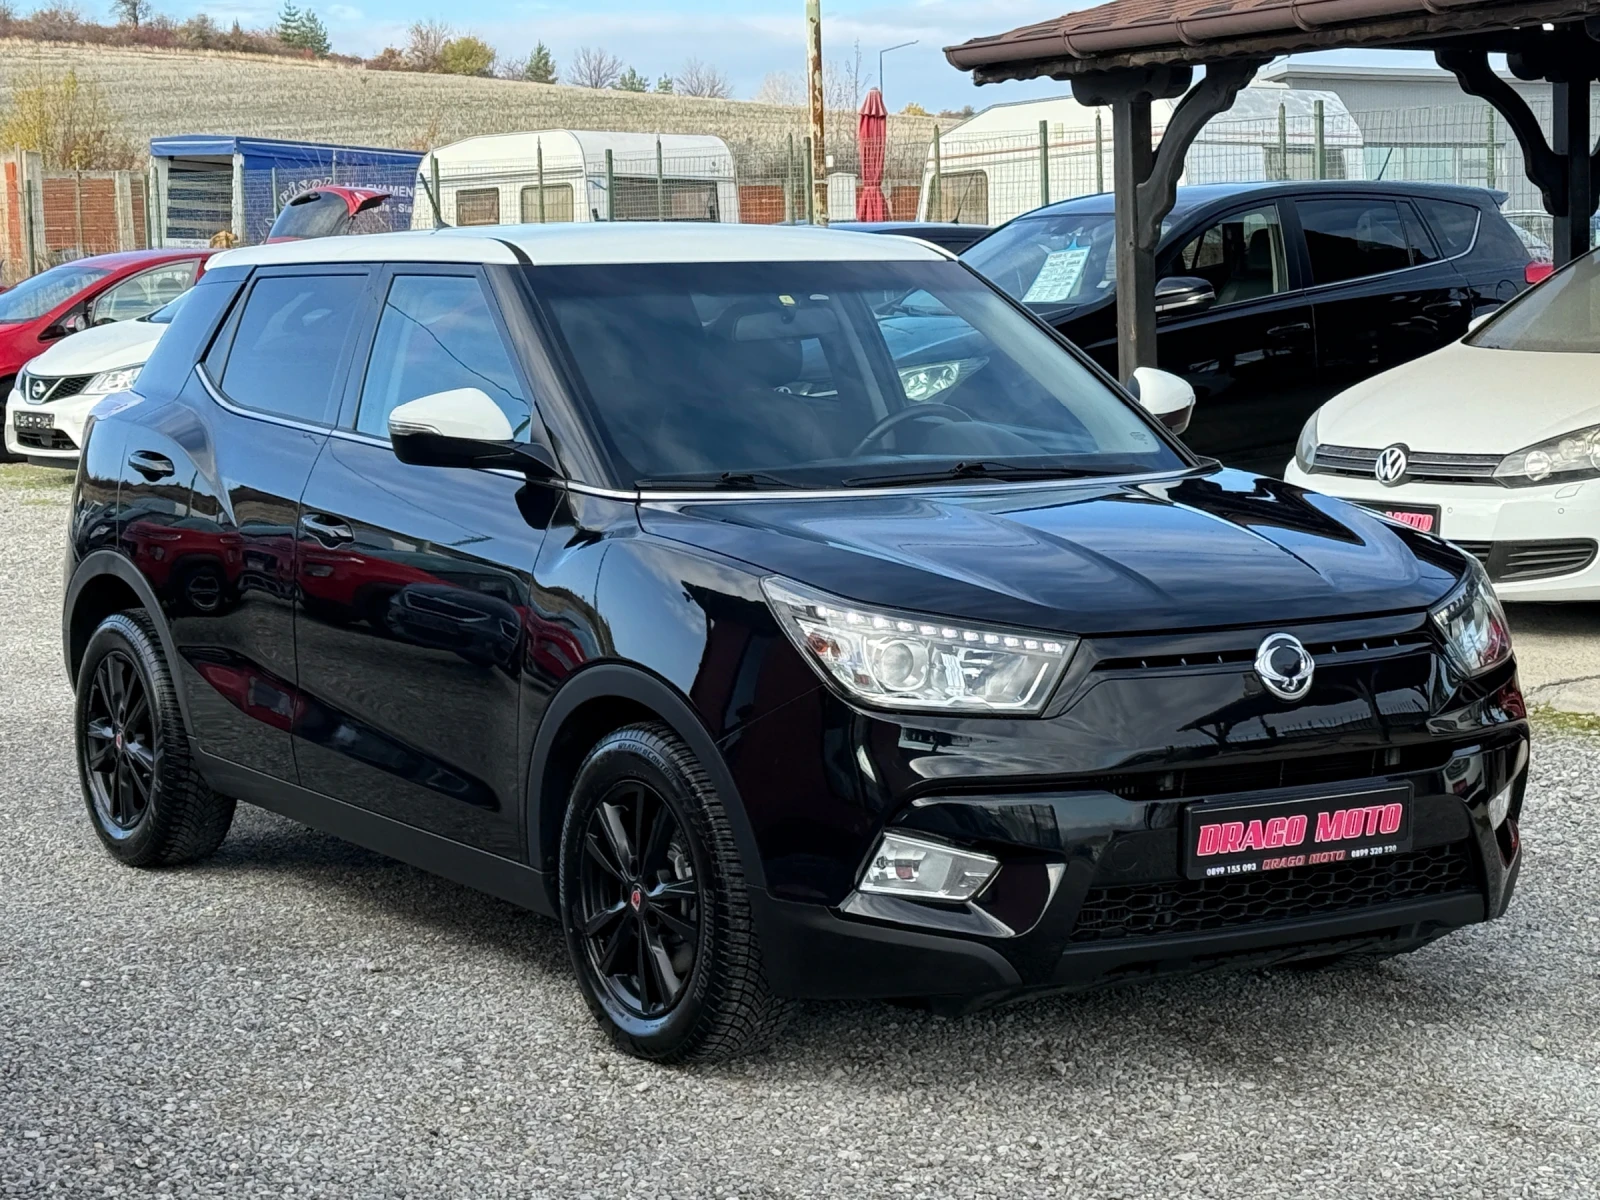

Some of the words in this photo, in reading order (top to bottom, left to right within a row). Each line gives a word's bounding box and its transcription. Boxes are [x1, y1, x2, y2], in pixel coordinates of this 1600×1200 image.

[1197, 815, 1307, 856] DRAGO
[1314, 803, 1402, 842] MOTO
[1206, 866, 1225, 876] 0899
[1227, 864, 1241, 874] 155
[1242, 863, 1257, 872] 093
[1262, 855, 1306, 871] DRAGO
[1308, 850, 1346, 865] MOTO
[1351, 848, 1369, 858] 0899
[1370, 846, 1383, 856] 320
